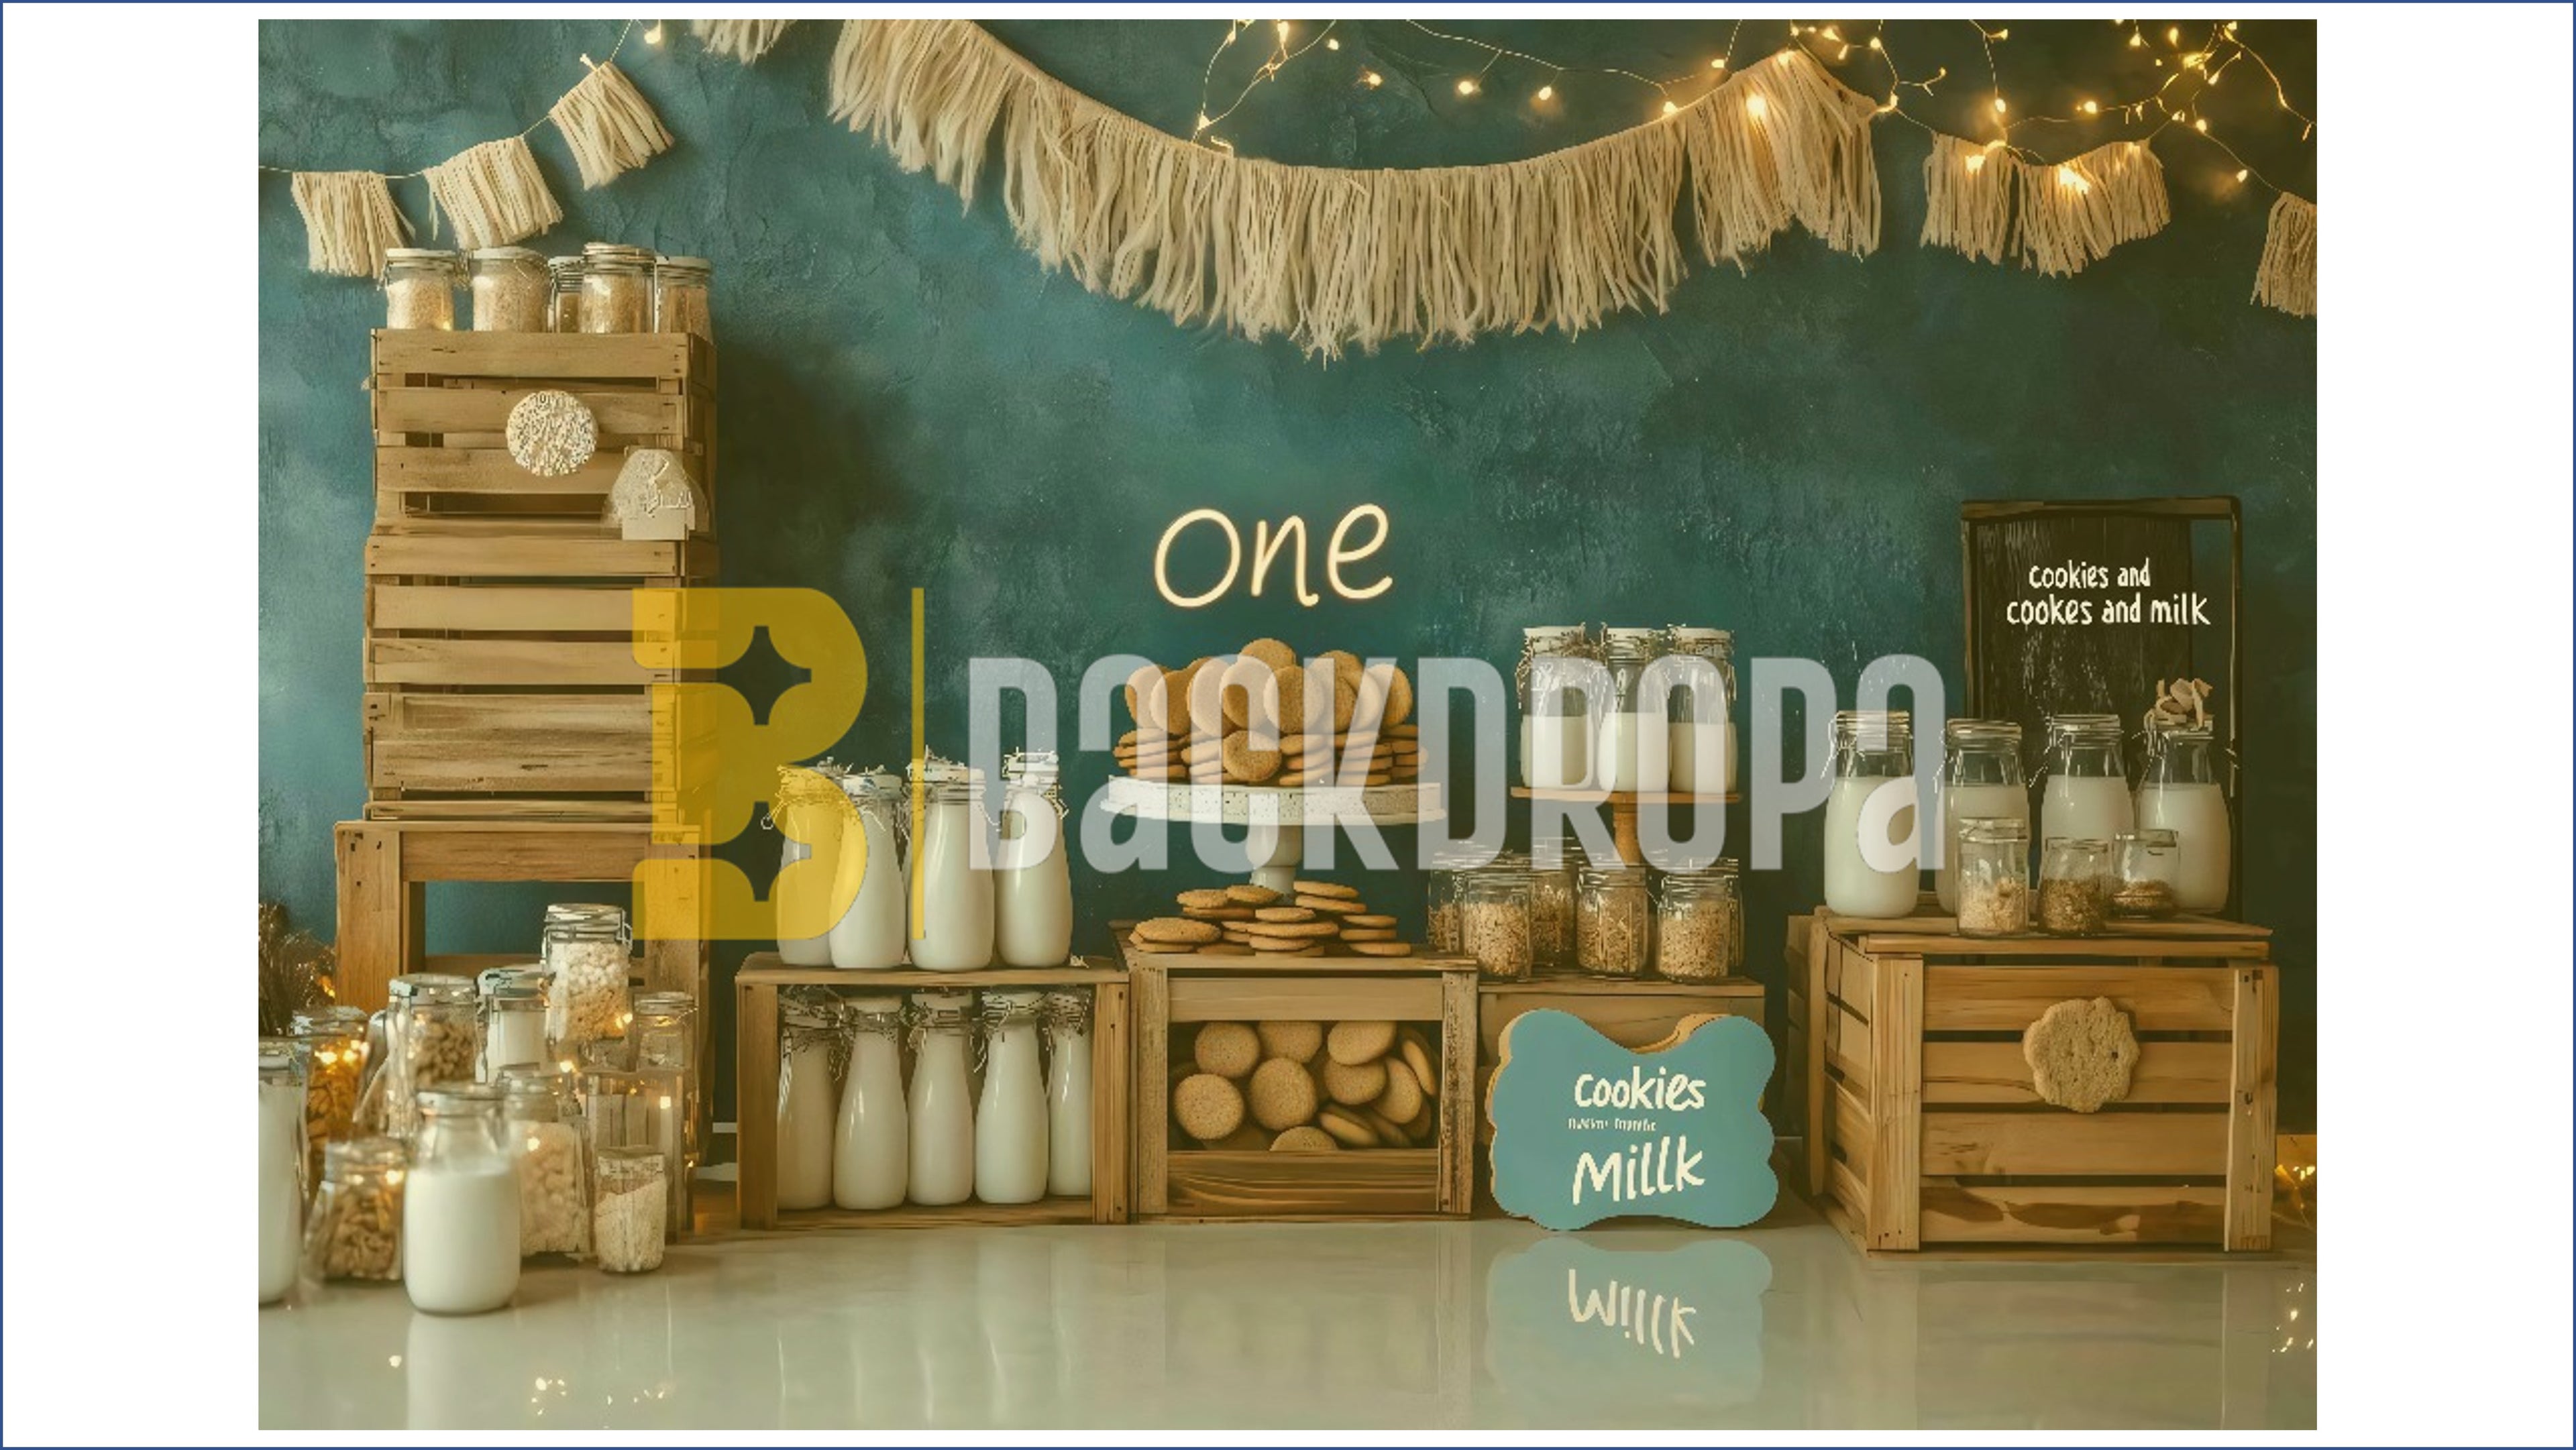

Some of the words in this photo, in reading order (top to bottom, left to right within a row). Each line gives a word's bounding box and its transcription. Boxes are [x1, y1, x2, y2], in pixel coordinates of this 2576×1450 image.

[1155, 503, 1393, 608] one
[2029, 559, 2109, 589] cookies
[2117, 557, 2151, 588] and
[2006, 594, 2093, 625] cookes
[2101, 592, 2141, 624] and
[2149, 592, 2211, 625] milk
[1572, 1135, 1706, 1206] Millk
